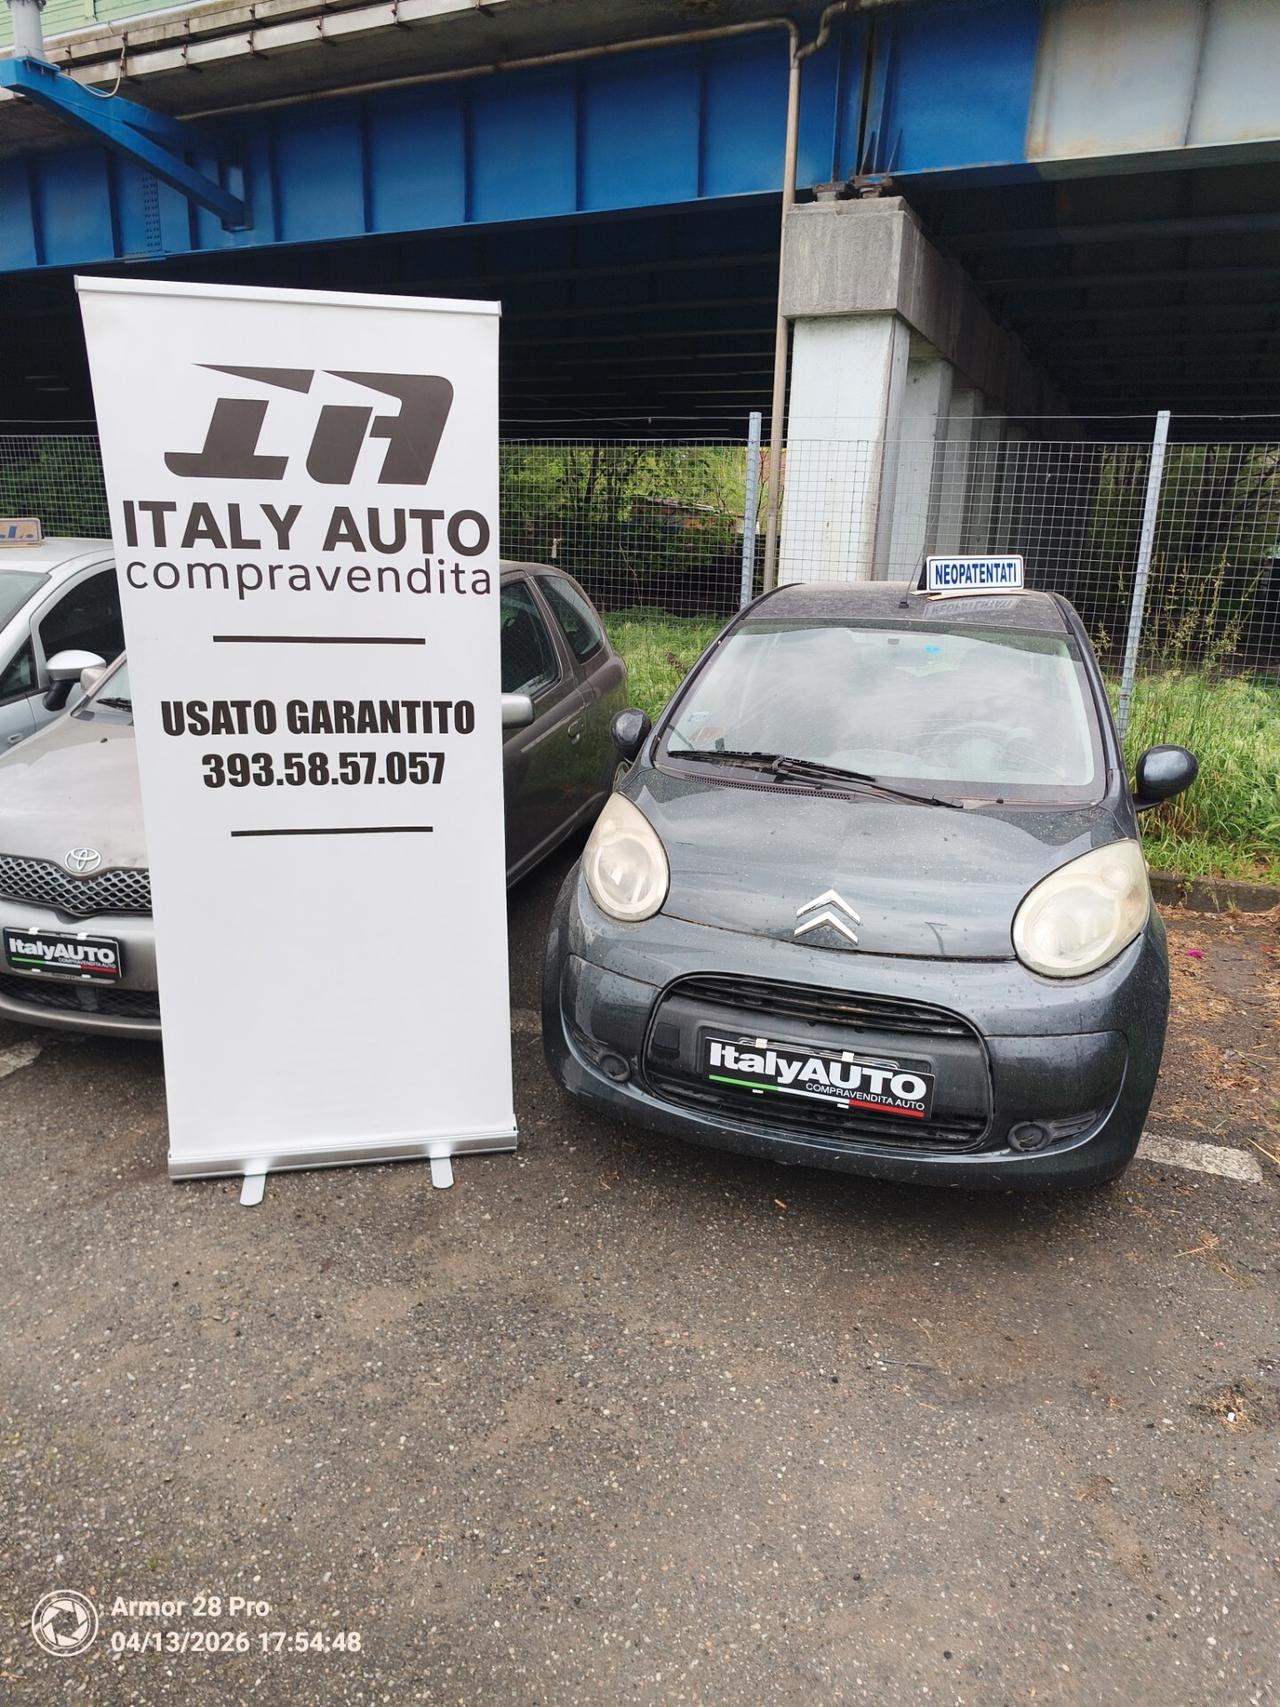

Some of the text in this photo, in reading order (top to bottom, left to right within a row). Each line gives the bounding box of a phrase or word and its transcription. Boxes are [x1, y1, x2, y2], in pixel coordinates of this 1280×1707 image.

[123, 500, 491, 557] ITALY AUTO
[126, 557, 491, 600] compravendita
[935, 563, 1017, 585] NEOPATENTATI
[161, 700, 475, 736] USATO GARANTITO
[202, 752, 446, 788] 393.58.57.057
[9, 938, 116, 964] ItalyAUTO
[709, 1042, 927, 1100] ItalyAUTO
[805, 1082, 925, 1111] COMPRAVENDITA AUTO
